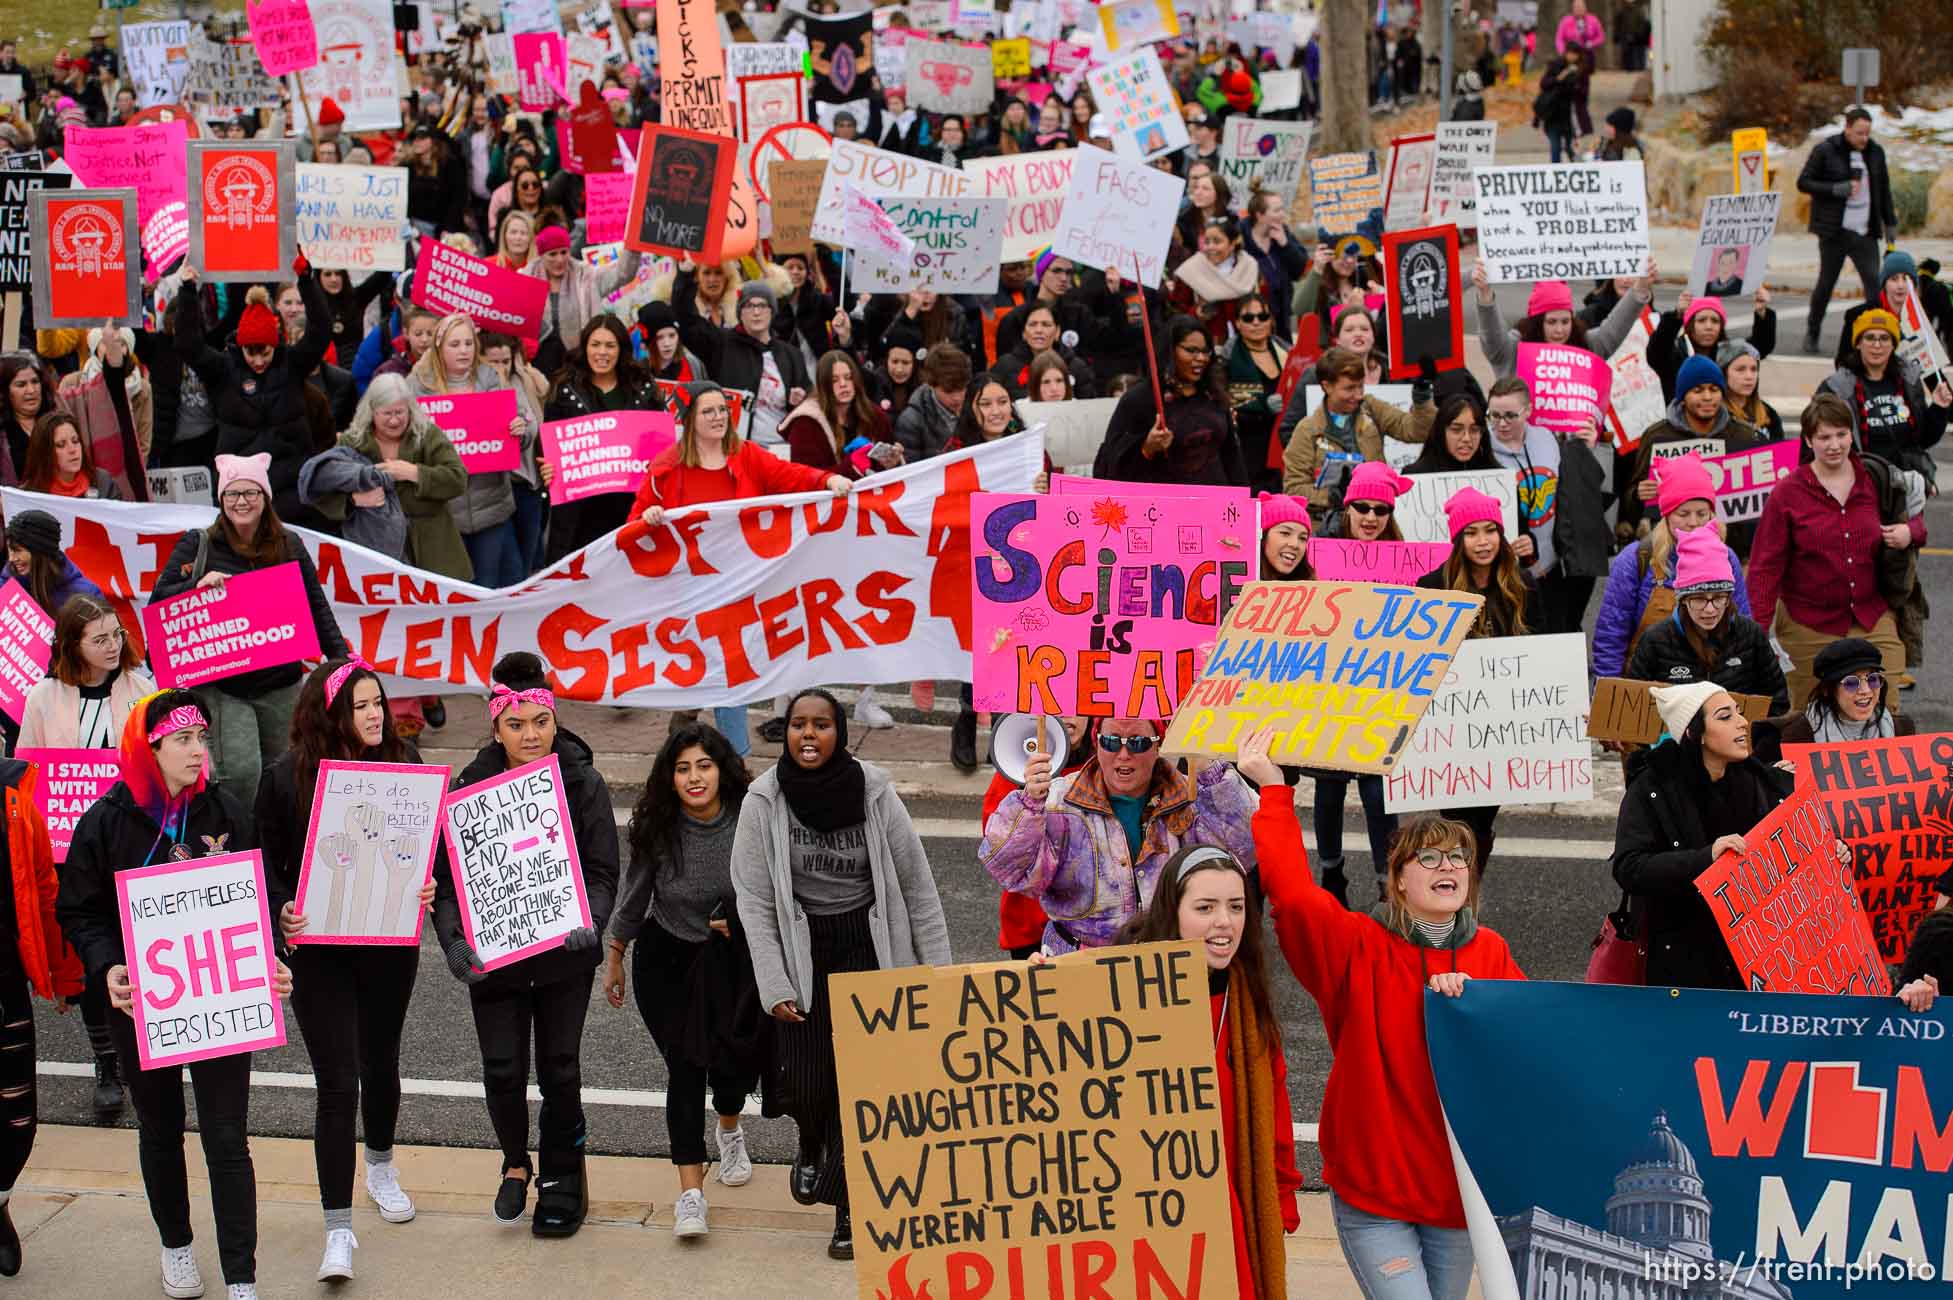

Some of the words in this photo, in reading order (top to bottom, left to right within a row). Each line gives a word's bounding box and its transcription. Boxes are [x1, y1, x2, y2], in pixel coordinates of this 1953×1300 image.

[664, 75, 721, 107] PERMIT
[297, 174, 345, 196] IRLS
[358, 173, 402, 197] JUST
[832, 144, 918, 192] STOP
[925, 166, 972, 197] THE
[985, 164, 1018, 198] MY
[1024, 158, 1073, 194] BODY
[1223, 159, 1261, 179] NOT
[1477, 169, 1601, 198] PRIVILEGE
[1609, 177, 1623, 196] is
[352, 201, 396, 220] HAVE
[1521, 200, 1559, 217] YOU
[301, 222, 398, 244] UNDAMENTAL
[655, 219, 700, 248] MORE
[1535, 216, 1638, 237] PROBLEM
[1700, 226, 1772, 247] EQUALITY
[431, 245, 439, 257] I
[441, 249, 489, 277] STAND
[1484, 242, 1537, 259] because
[431, 257, 469, 284] WITH
[1500, 258, 1642, 281] PERSONALLY
[427, 270, 495, 306] PLANNED
[424, 283, 526, 326] PARENTHOOD
[1535, 349, 1593, 370] JUNTOS
[1535, 364, 1572, 380] CON
[555, 426, 563, 440] I
[566, 417, 618, 437] STAND
[558, 434, 600, 455] WITH
[560, 446, 634, 469] PLANNED
[615, 511, 720, 578] OF
[1338, 543, 1380, 570] YOU
[1387, 543, 1441, 573] TAKE
[9, 592, 21, 606] I
[159, 606, 167, 621] I
[169, 587, 229, 618] STAND
[0, 605, 34, 647] WITH
[162, 608, 211, 636] WITH
[1231, 585, 1353, 638] GIRLS
[1353, 587, 1478, 647] JUST
[165, 616, 250, 653] PLANNED
[169, 624, 296, 670] PARENTHOOD
[537, 571, 916, 702] SISTERS
[1089, 612, 1135, 656] is
[1206, 637, 1329, 685] WANNA
[1332, 646, 1453, 697] HAVE
[1511, 684, 1569, 711] HAVE
[1180, 708, 1410, 767] RIGHTS!
[48, 763, 55, 778] I
[58, 762, 120, 778] STAND
[327, 773, 377, 796] Let's
[386, 781, 411, 798] do
[1387, 762, 1493, 802] HUMAN
[1506, 755, 1592, 793] RIGHTS
[48, 780, 97, 796] WITH
[495, 769, 554, 809] LIVES
[387, 813, 430, 827] BITCH
[391, 800, 431, 813] this
[459, 809, 515, 856] BEGIN
[512, 802, 540, 832] TO
[464, 842, 508, 879] END
[466, 872, 498, 898] THE
[499, 860, 524, 884] DAY
[526, 849, 556, 871] WE
[801, 854, 857, 873] WOMAN
[472, 879, 527, 916] BECOME
[527, 858, 571, 888] SILENT
[1713, 881, 1745, 929] I
[1769, 827, 1800, 876] I
[480, 896, 522, 930] ABOUT
[519, 886, 574, 912] THINGS
[475, 922, 507, 948] THAT
[144, 921, 267, 1010] SHE
[850, 983, 931, 1035] WE
[958, 963, 1059, 1027] ARE
[1095, 950, 1193, 1012] THE
[146, 1001, 275, 1049] PERSISTED
[1875, 1016, 1947, 1041] AND
[940, 1015, 1163, 1084] GRAND-
[854, 1081, 1060, 1143] DAUGHTERS
[1079, 1074, 1126, 1121] OF
[1135, 1066, 1215, 1116] THE
[862, 1128, 1123, 1210] WITCHES
[1140, 1128, 1221, 1182] YOU
[865, 1202, 1014, 1253] WEREN'T
[1029, 1194, 1117, 1237] ABLE
[1135, 1187, 1186, 1228] TO
